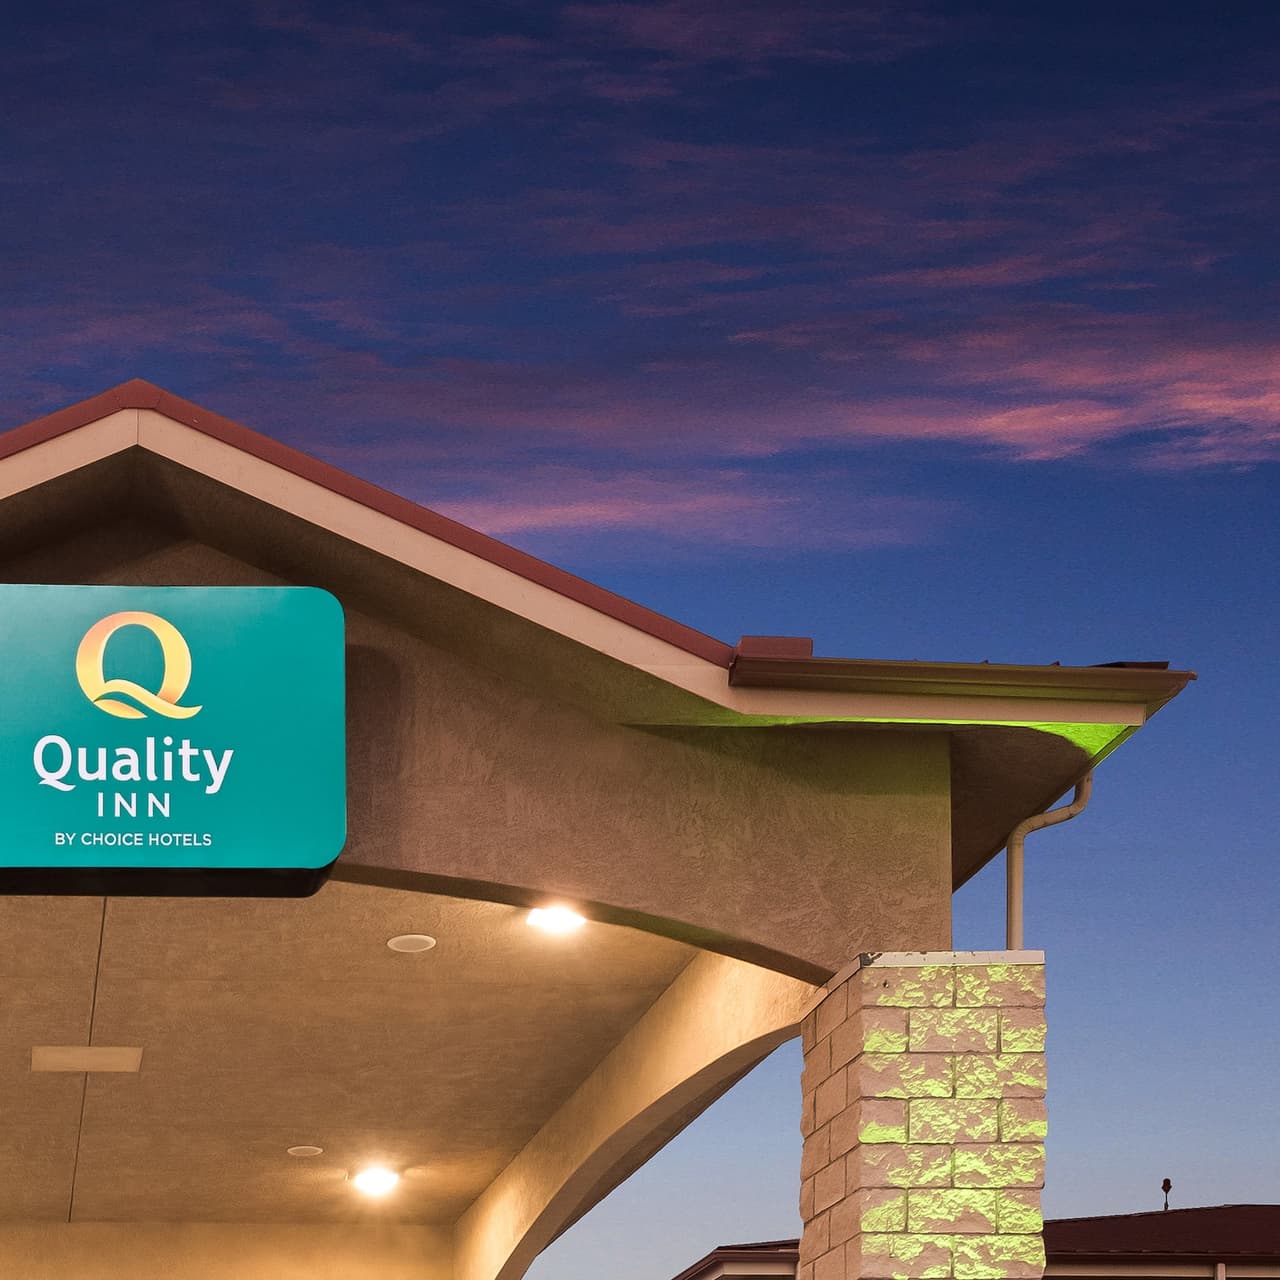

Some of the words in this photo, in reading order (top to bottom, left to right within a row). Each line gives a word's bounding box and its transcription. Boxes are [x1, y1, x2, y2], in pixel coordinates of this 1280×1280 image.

[75, 610, 203, 720] Q
[33, 734, 234, 795] Quality
[97, 792, 170, 818] INN
[55, 832, 76, 845] BY
[81, 832, 143, 846] CHOICE
[148, 833, 212, 846] HOTELS
